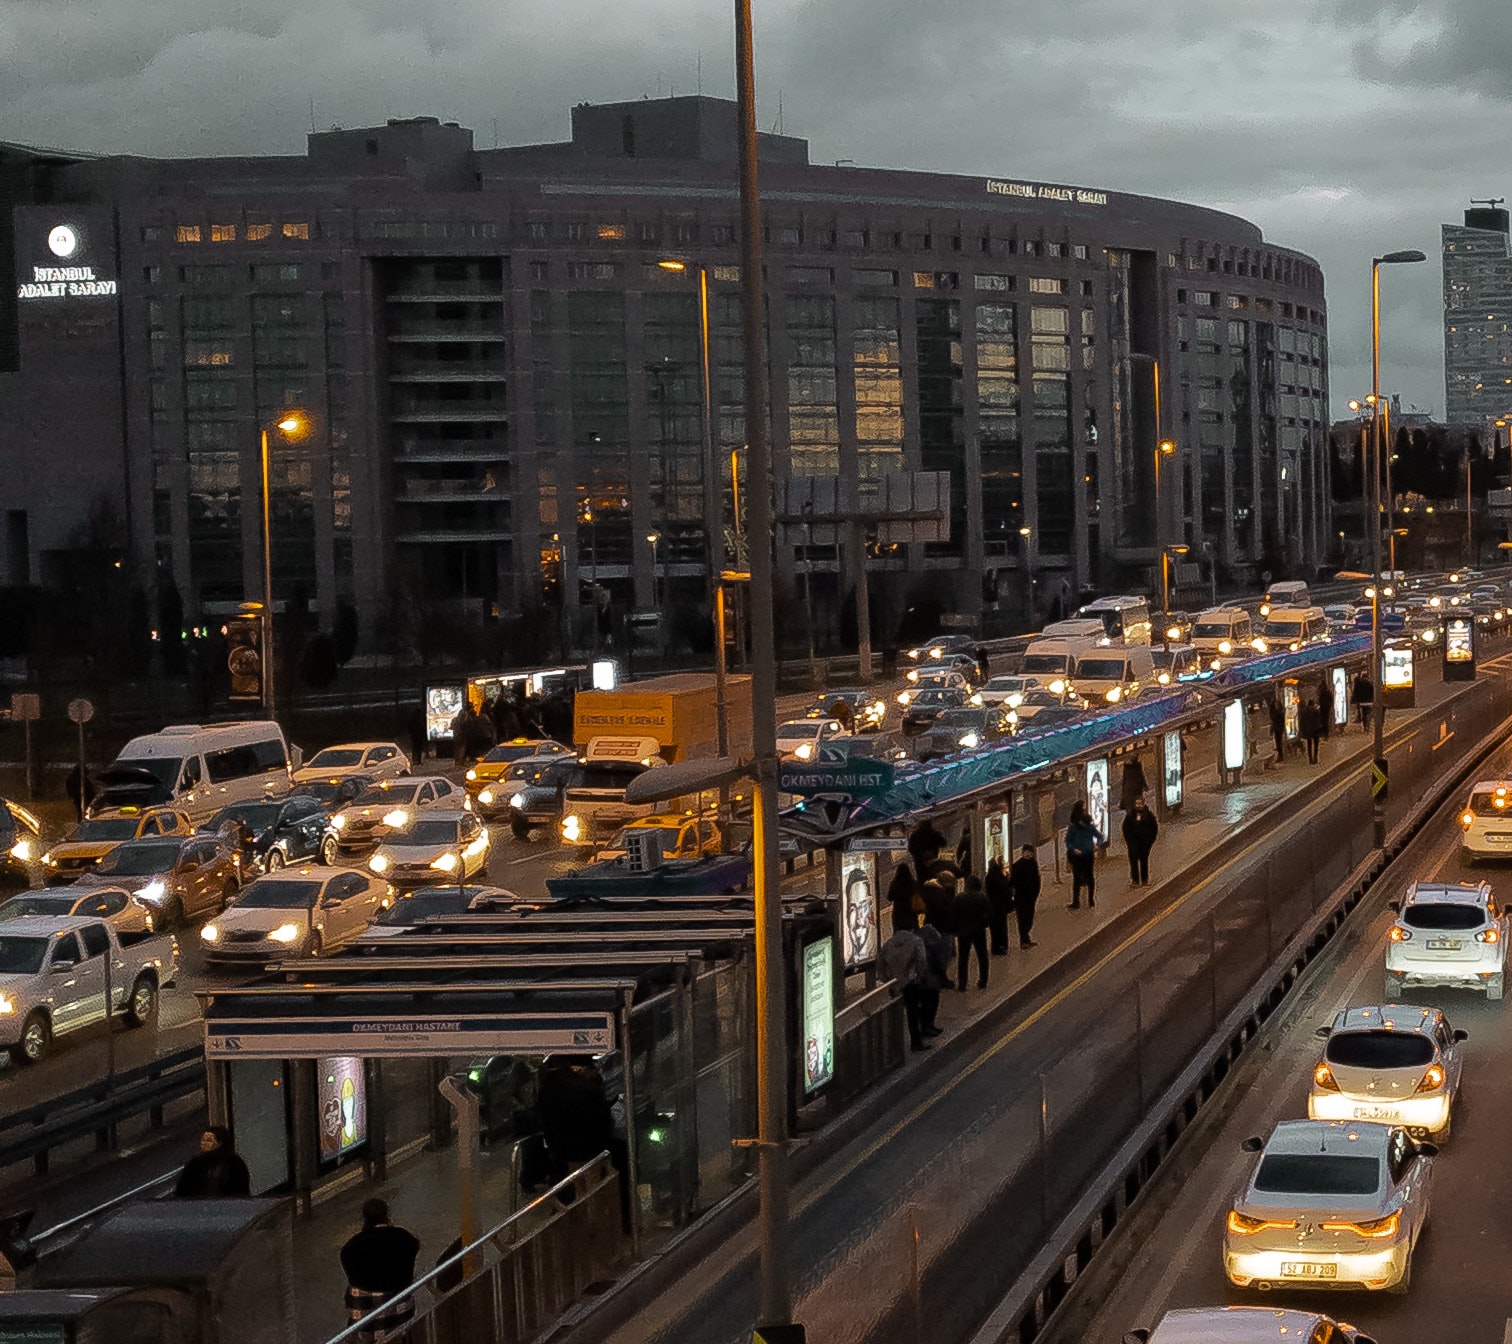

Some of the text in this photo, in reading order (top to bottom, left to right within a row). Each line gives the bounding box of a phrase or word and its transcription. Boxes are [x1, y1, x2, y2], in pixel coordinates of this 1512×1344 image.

[33, 266, 96, 282] İSTANBUL
[18, 281, 117, 298] ADALET SARAYI
[781, 773, 856, 788] OKMEYDANI
